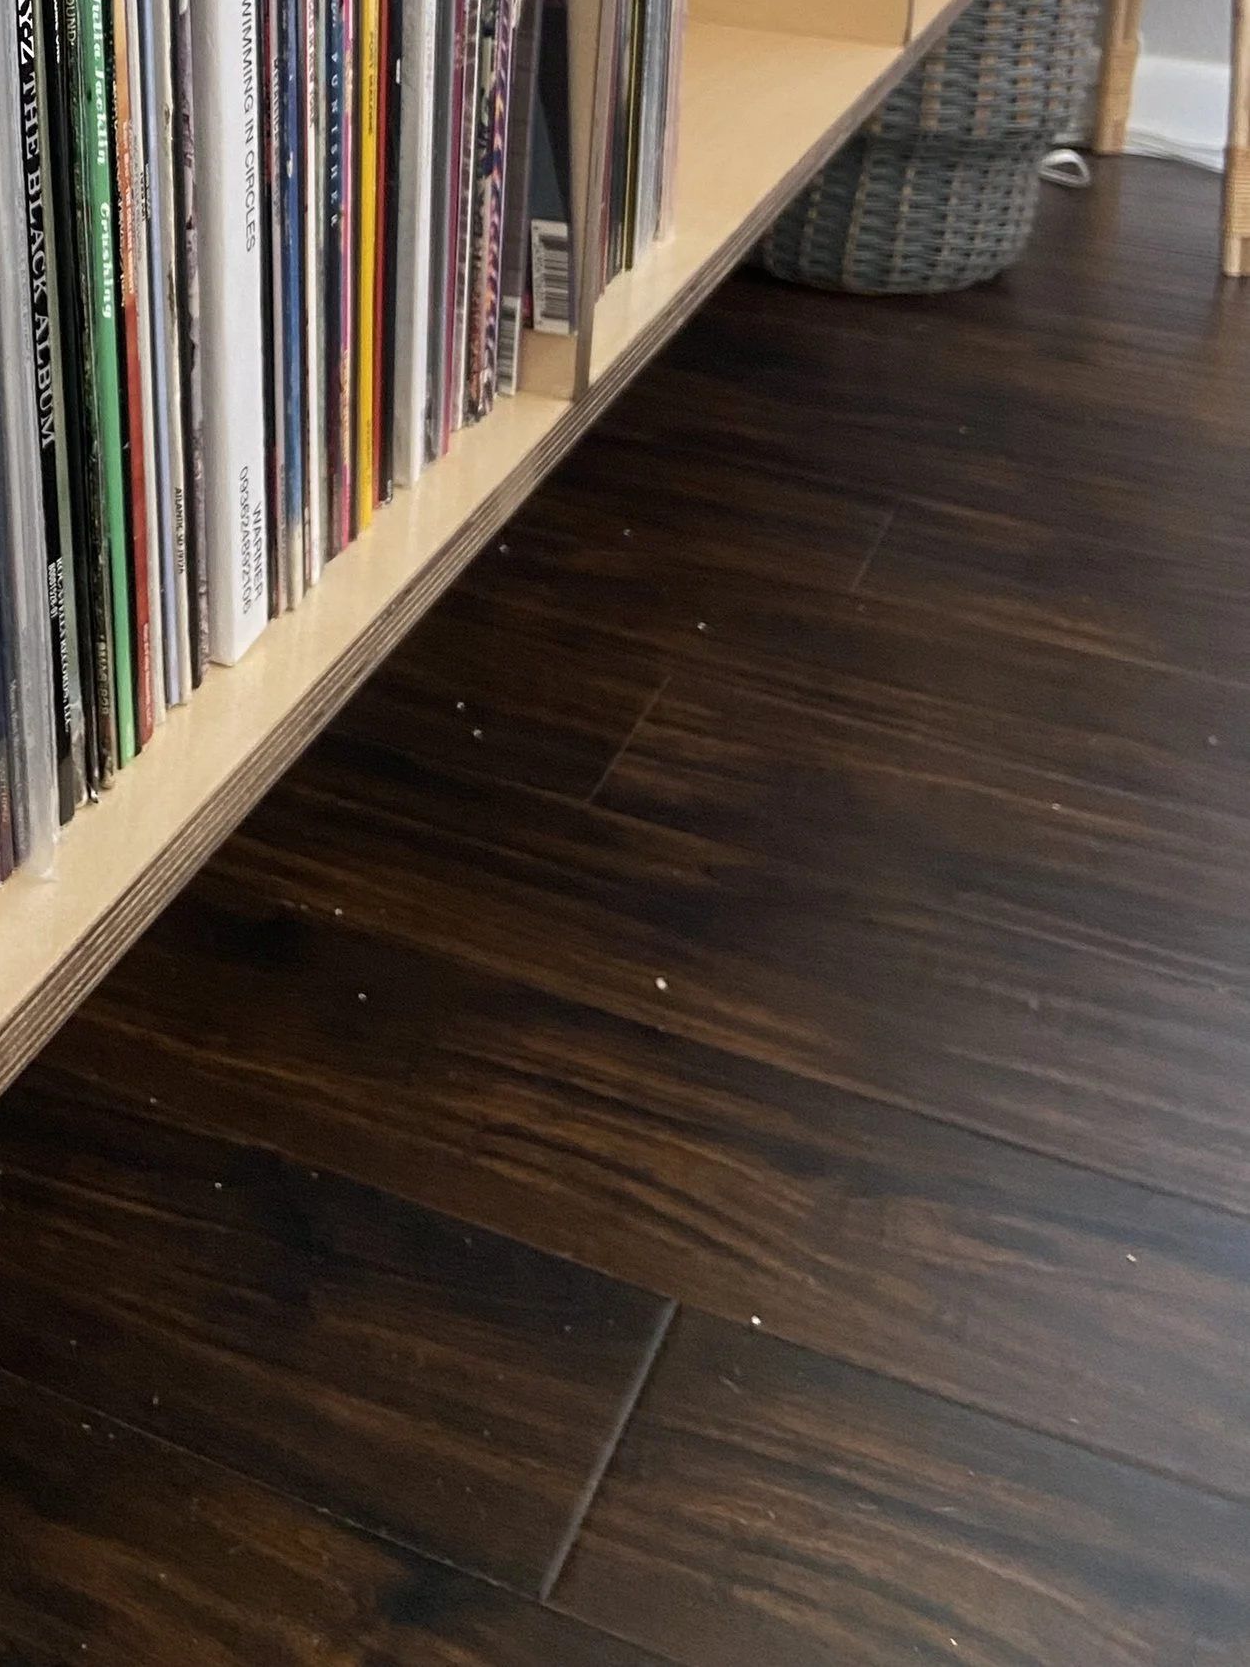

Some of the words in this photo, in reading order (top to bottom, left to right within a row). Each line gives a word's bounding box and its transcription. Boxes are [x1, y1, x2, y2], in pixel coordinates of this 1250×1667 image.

[22, 72, 40, 160] THE
[94, 68, 108, 166] Jacklin
[244, 120, 255, 143] IN
[27, 165, 48, 304] BLACK
[245, 149, 256, 252] CIRCLES
[99, 202, 113, 319] Crushing
[35, 312, 56, 449] ALBUM
[175, 486, 184, 529] ATLANTIC
[252, 501, 264, 600] WARNER
